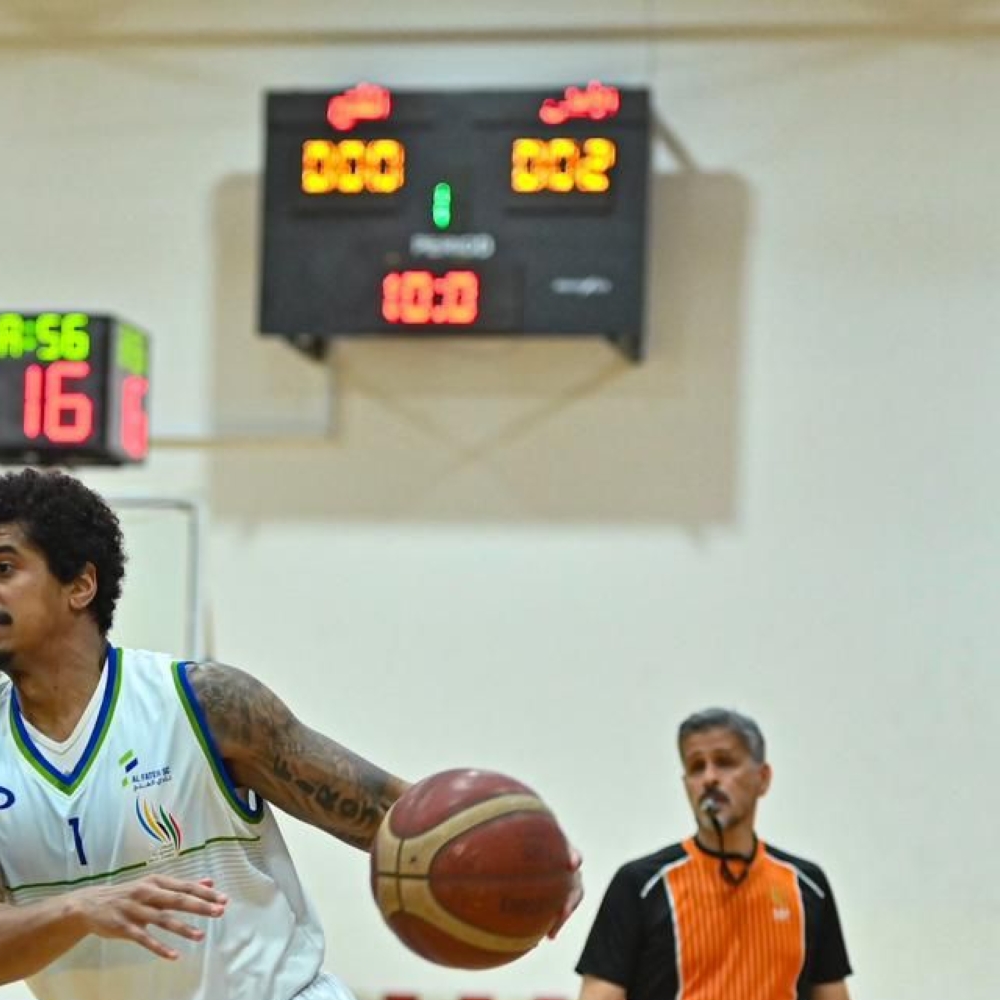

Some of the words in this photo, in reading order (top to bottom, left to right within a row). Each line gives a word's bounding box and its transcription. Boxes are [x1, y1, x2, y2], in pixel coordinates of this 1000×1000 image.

[302, 139, 404, 193] 000
[511, 138, 616, 192] 002
[23, 361, 93, 443] 16
[69, 817, 87, 865] 1
